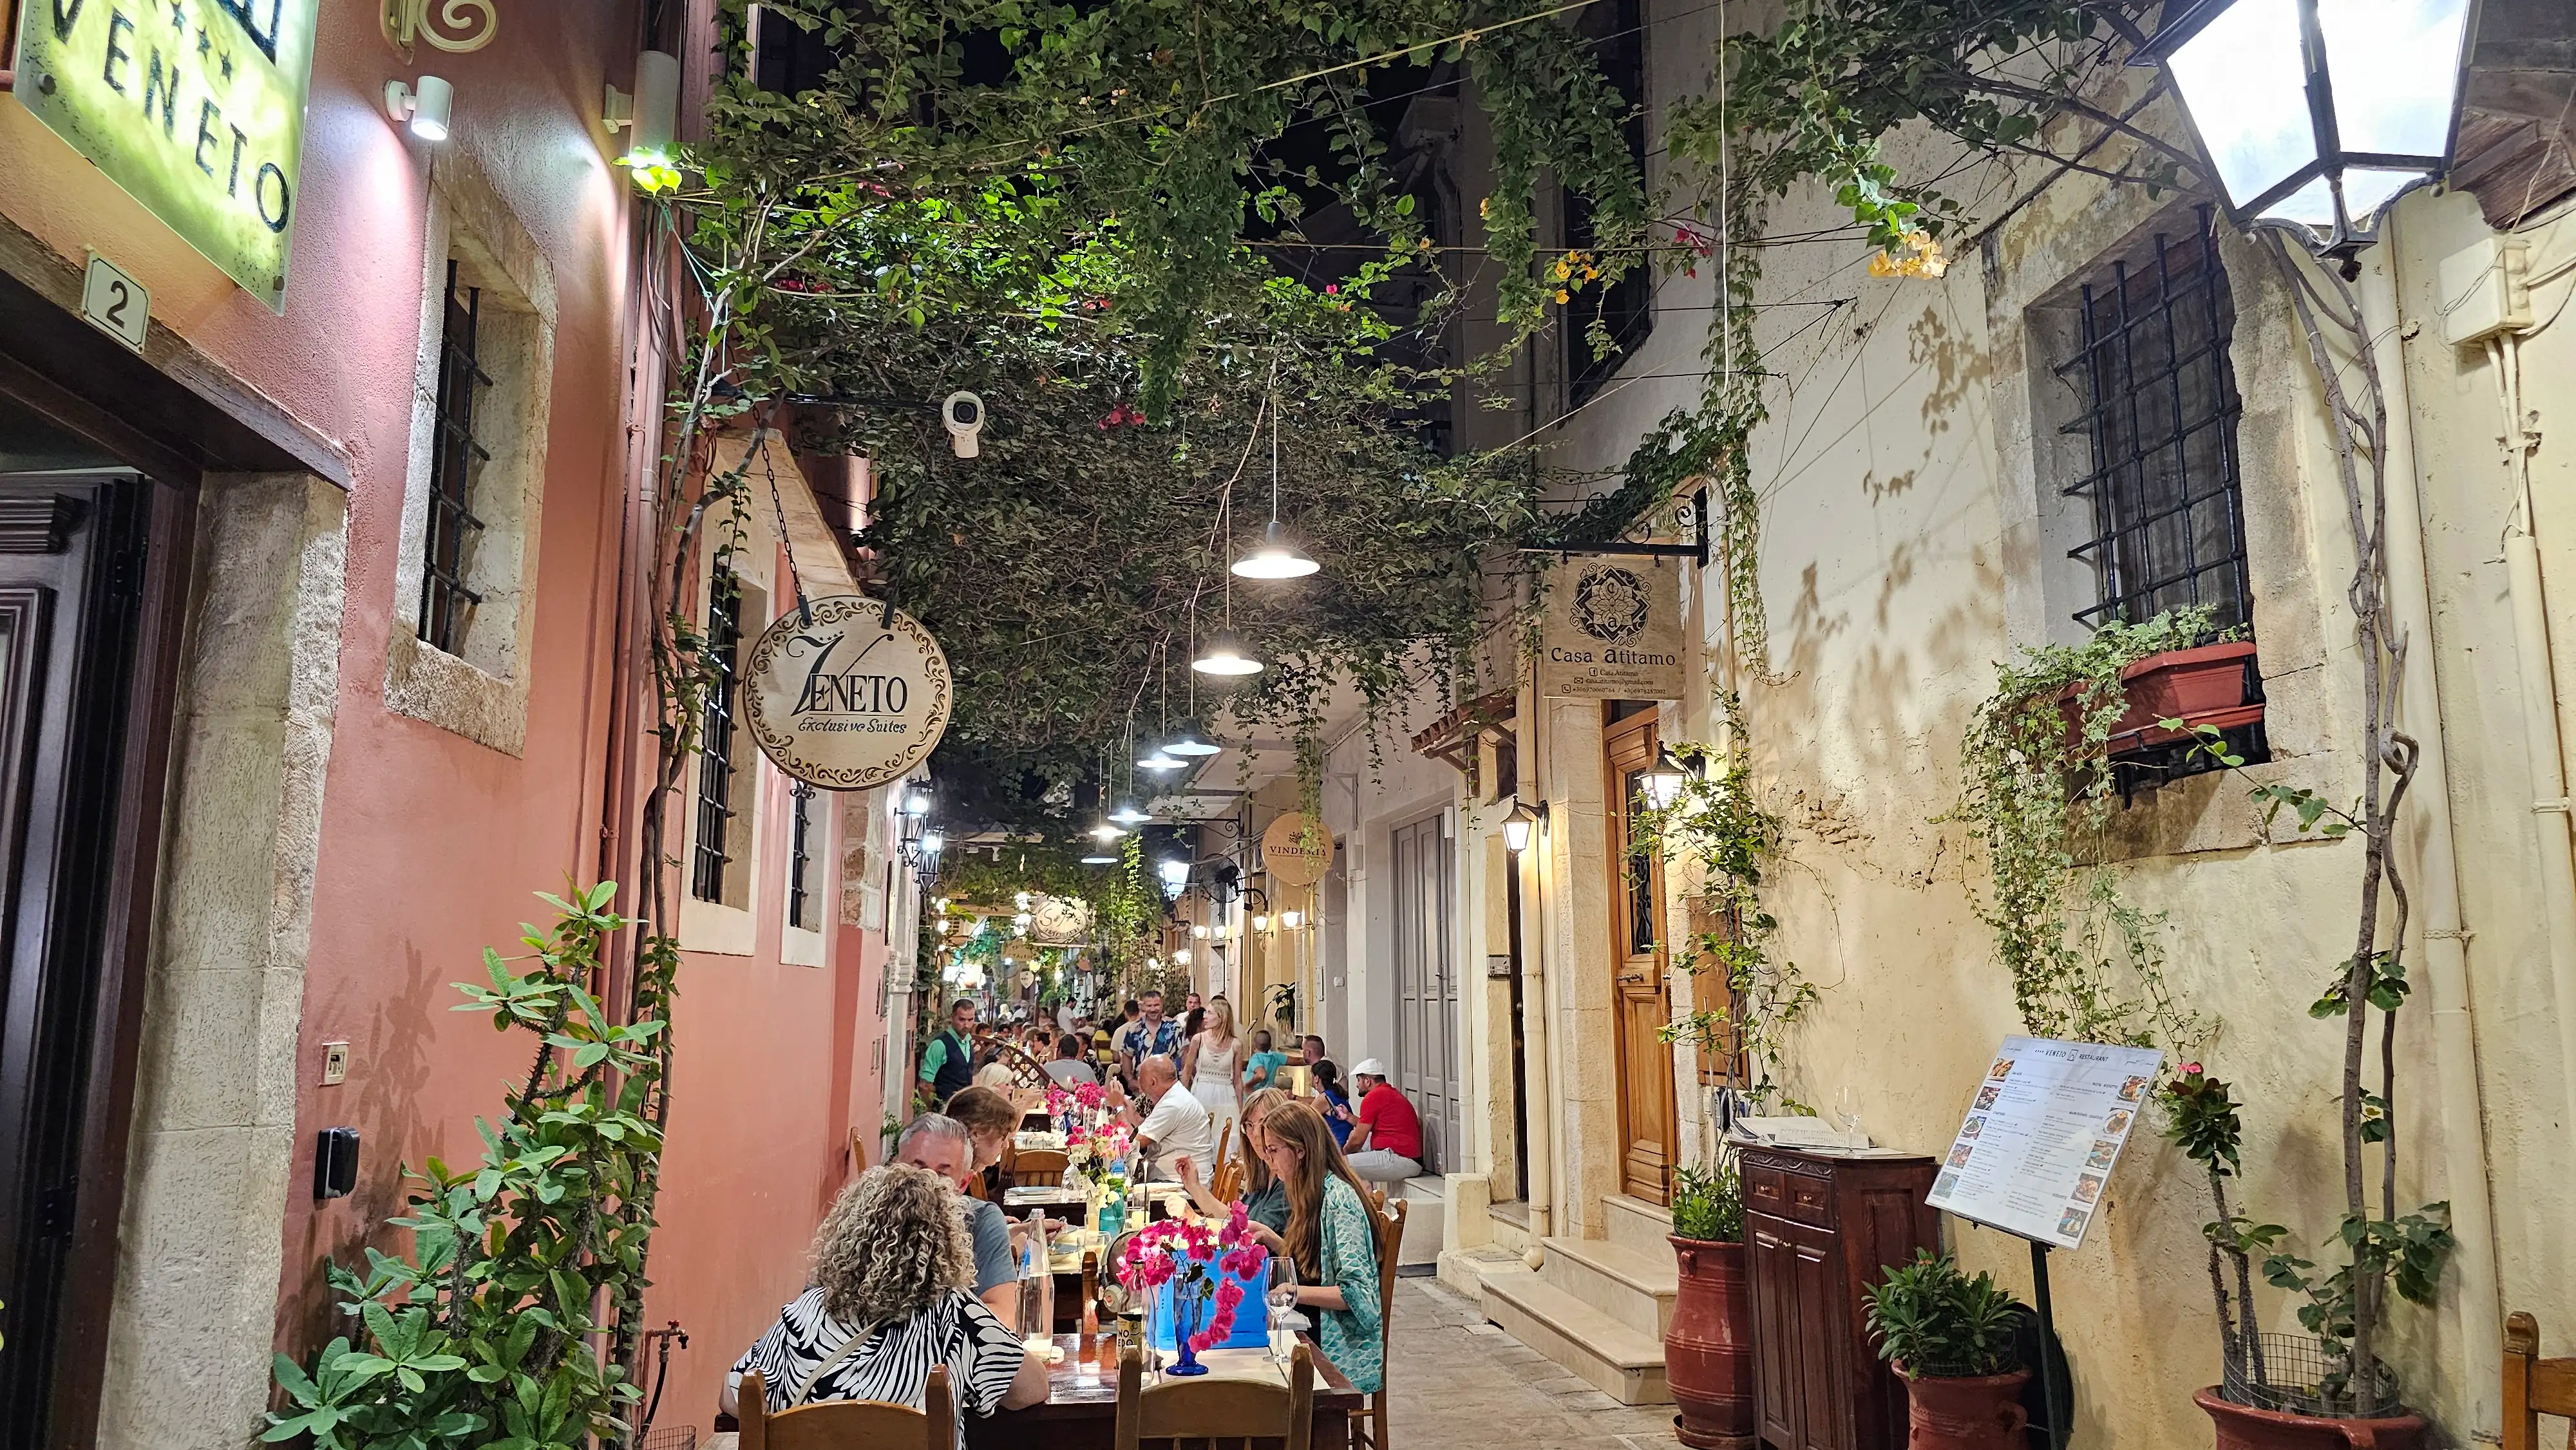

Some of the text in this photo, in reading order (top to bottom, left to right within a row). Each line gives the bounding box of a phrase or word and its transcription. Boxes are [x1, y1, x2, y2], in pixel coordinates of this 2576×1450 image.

[52, 0, 290, 233] VENETO
[106, 280, 129, 328] 2
[1551, 647, 1593, 663] Casa
[786, 633, 908, 717] VENETO
[799, 717, 907, 734] Exclusive Suites
[2045, 1050, 2110, 1063] VENETO RESTAURANT
